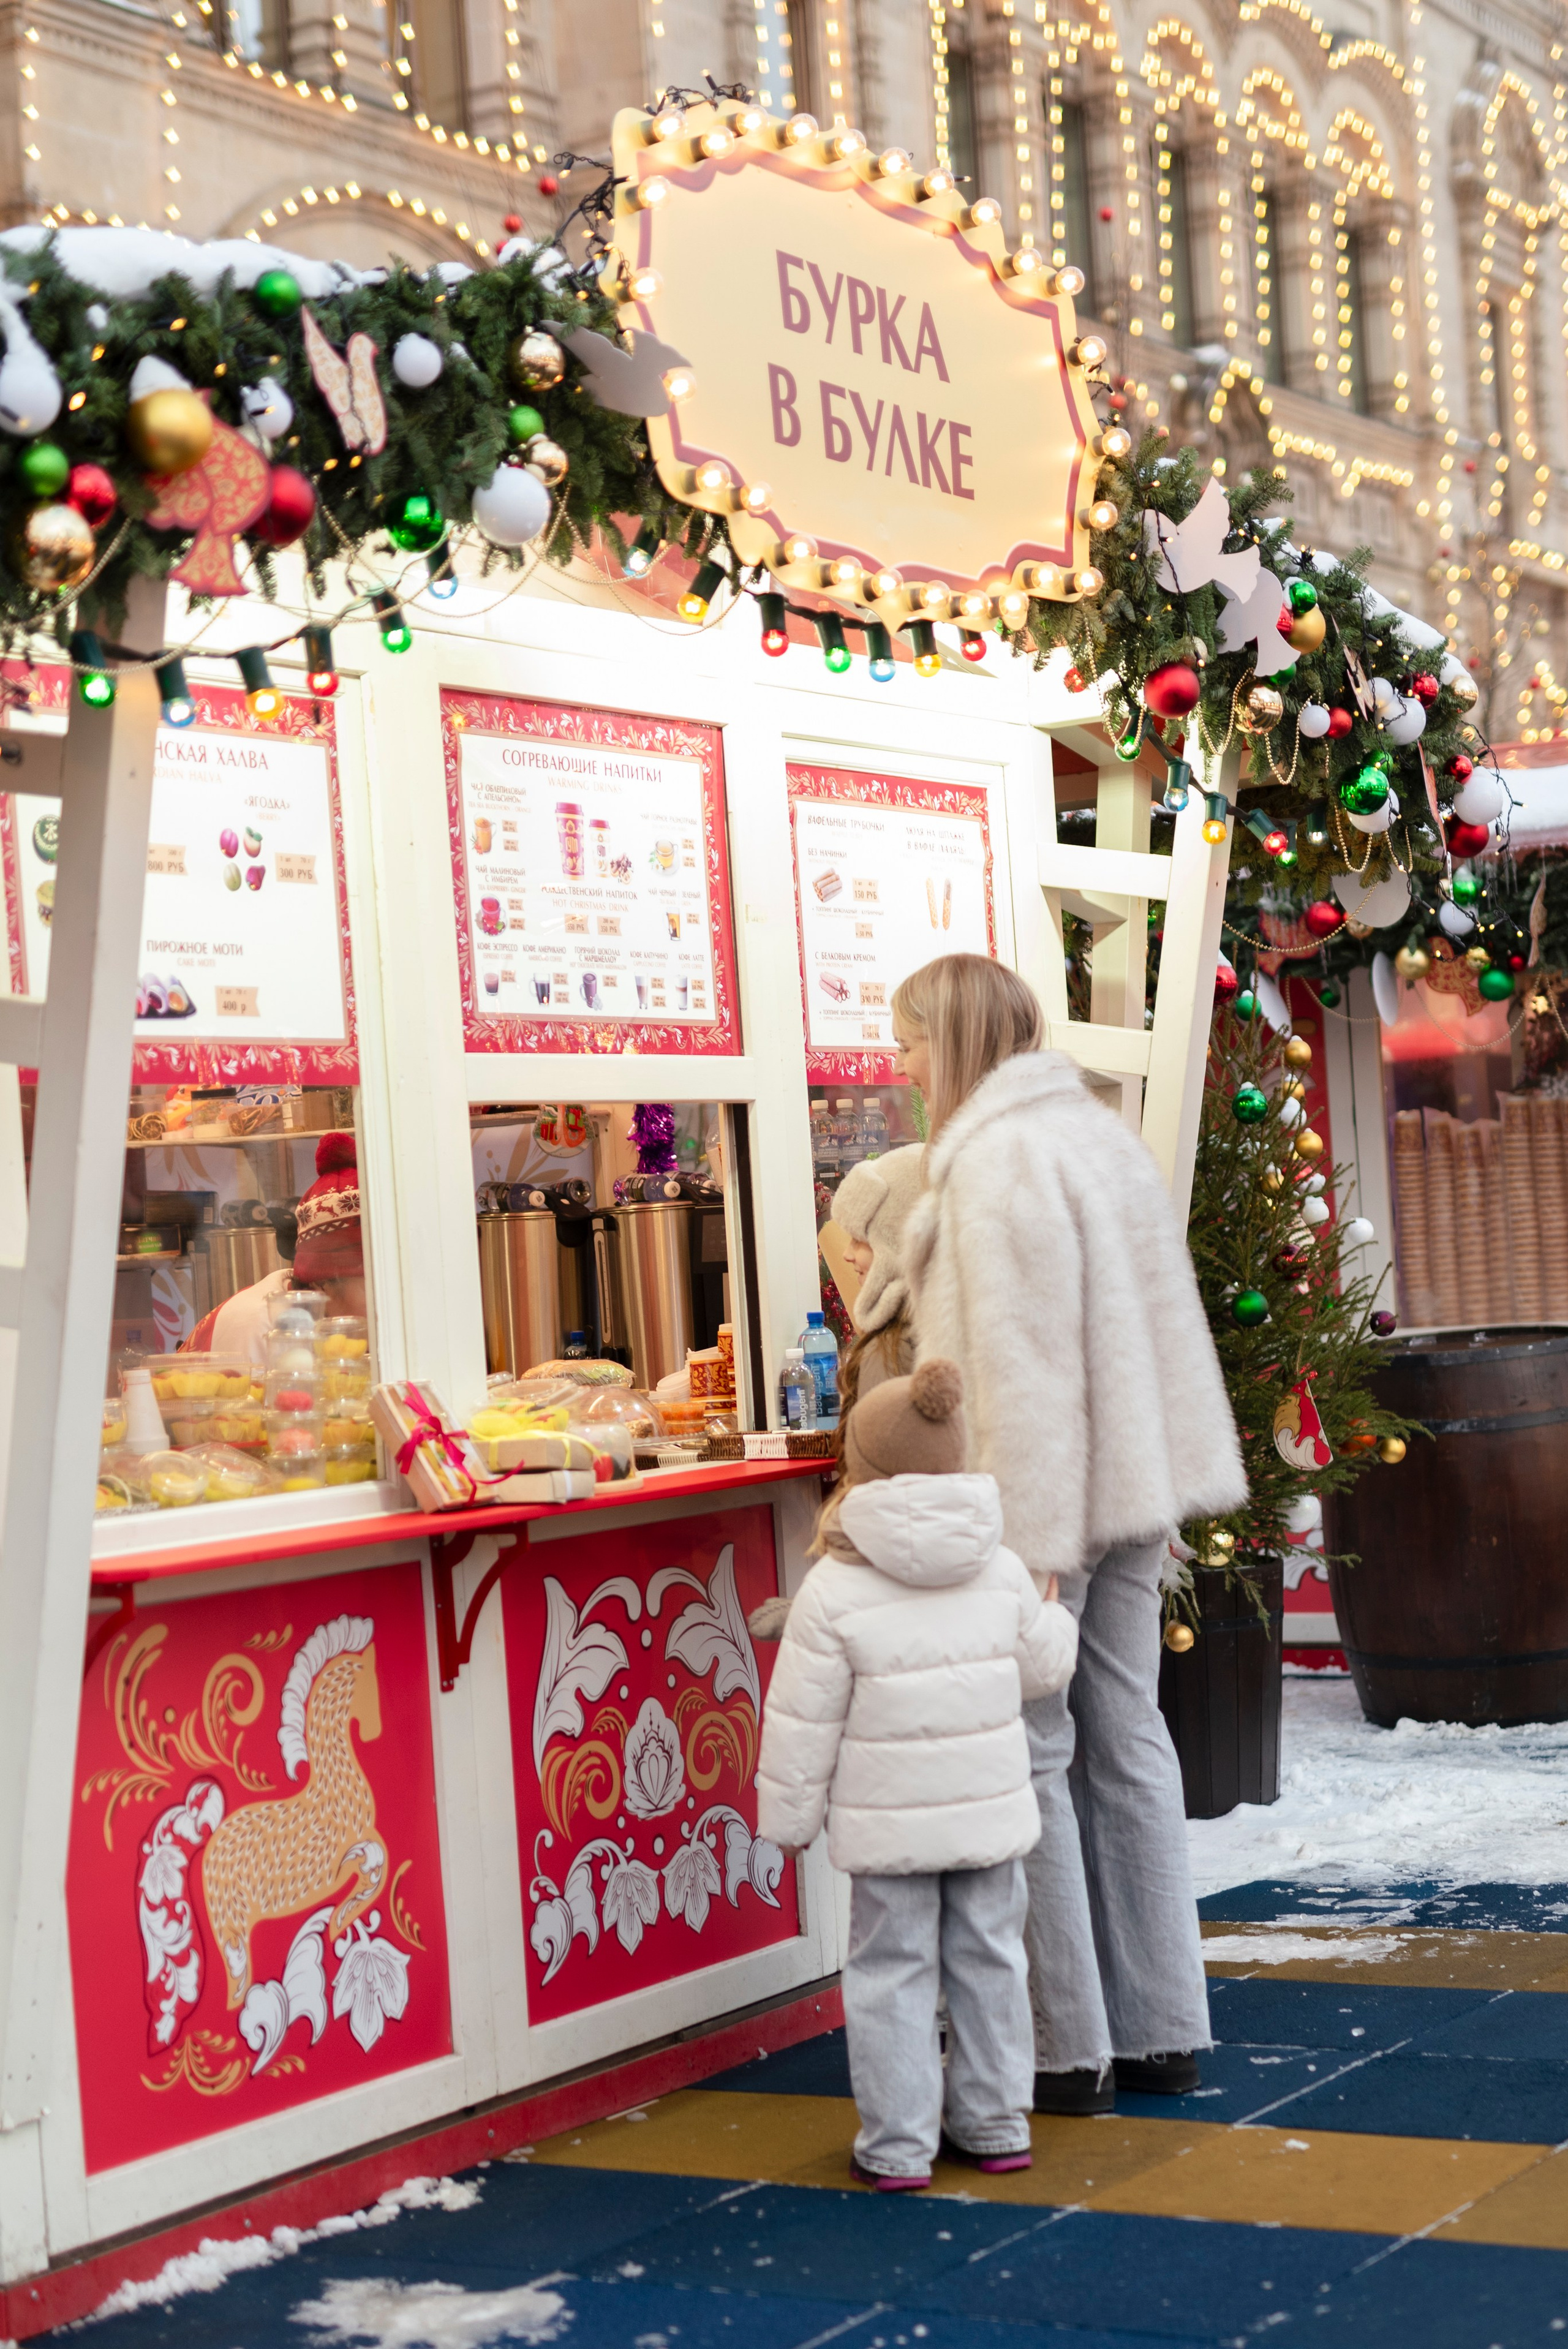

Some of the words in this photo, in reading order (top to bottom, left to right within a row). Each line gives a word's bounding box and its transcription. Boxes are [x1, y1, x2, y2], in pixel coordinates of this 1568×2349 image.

[776, 249, 950, 383] БУРКА
[767, 362, 801, 447] В
[820, 380, 974, 500] БУЛКЕ
[216, 747, 269, 770] ХАЛВА
[502, 748, 598, 775] СОГРЕВАЮЩИЕ
[604, 761, 662, 783] НАПИТКИ
[548, 775, 589, 791] WARMING
[808, 847, 818, 856] БЕЗ
[820, 849, 848, 858] НАЧИНКИ
[168, 861, 184, 873] РУБ
[279, 867, 293, 878] 300
[298, 868, 312, 880] РУБ
[606, 889, 638, 900] НАПИТОК
[854, 890, 864, 899] 150
[867, 890, 877, 899] РУБ
[552, 899, 567, 908] HOT
[570, 900, 606, 911] CHRISTMAS
[146, 940, 208, 954] ПИРОЖНОЕ
[213, 943, 243, 956] МОТИ
[821, 952, 851, 961] БЕЛКОВЫМ
[853, 953, 876, 962] КРЕМОМ
[873, 995, 884, 1004] РУБ
